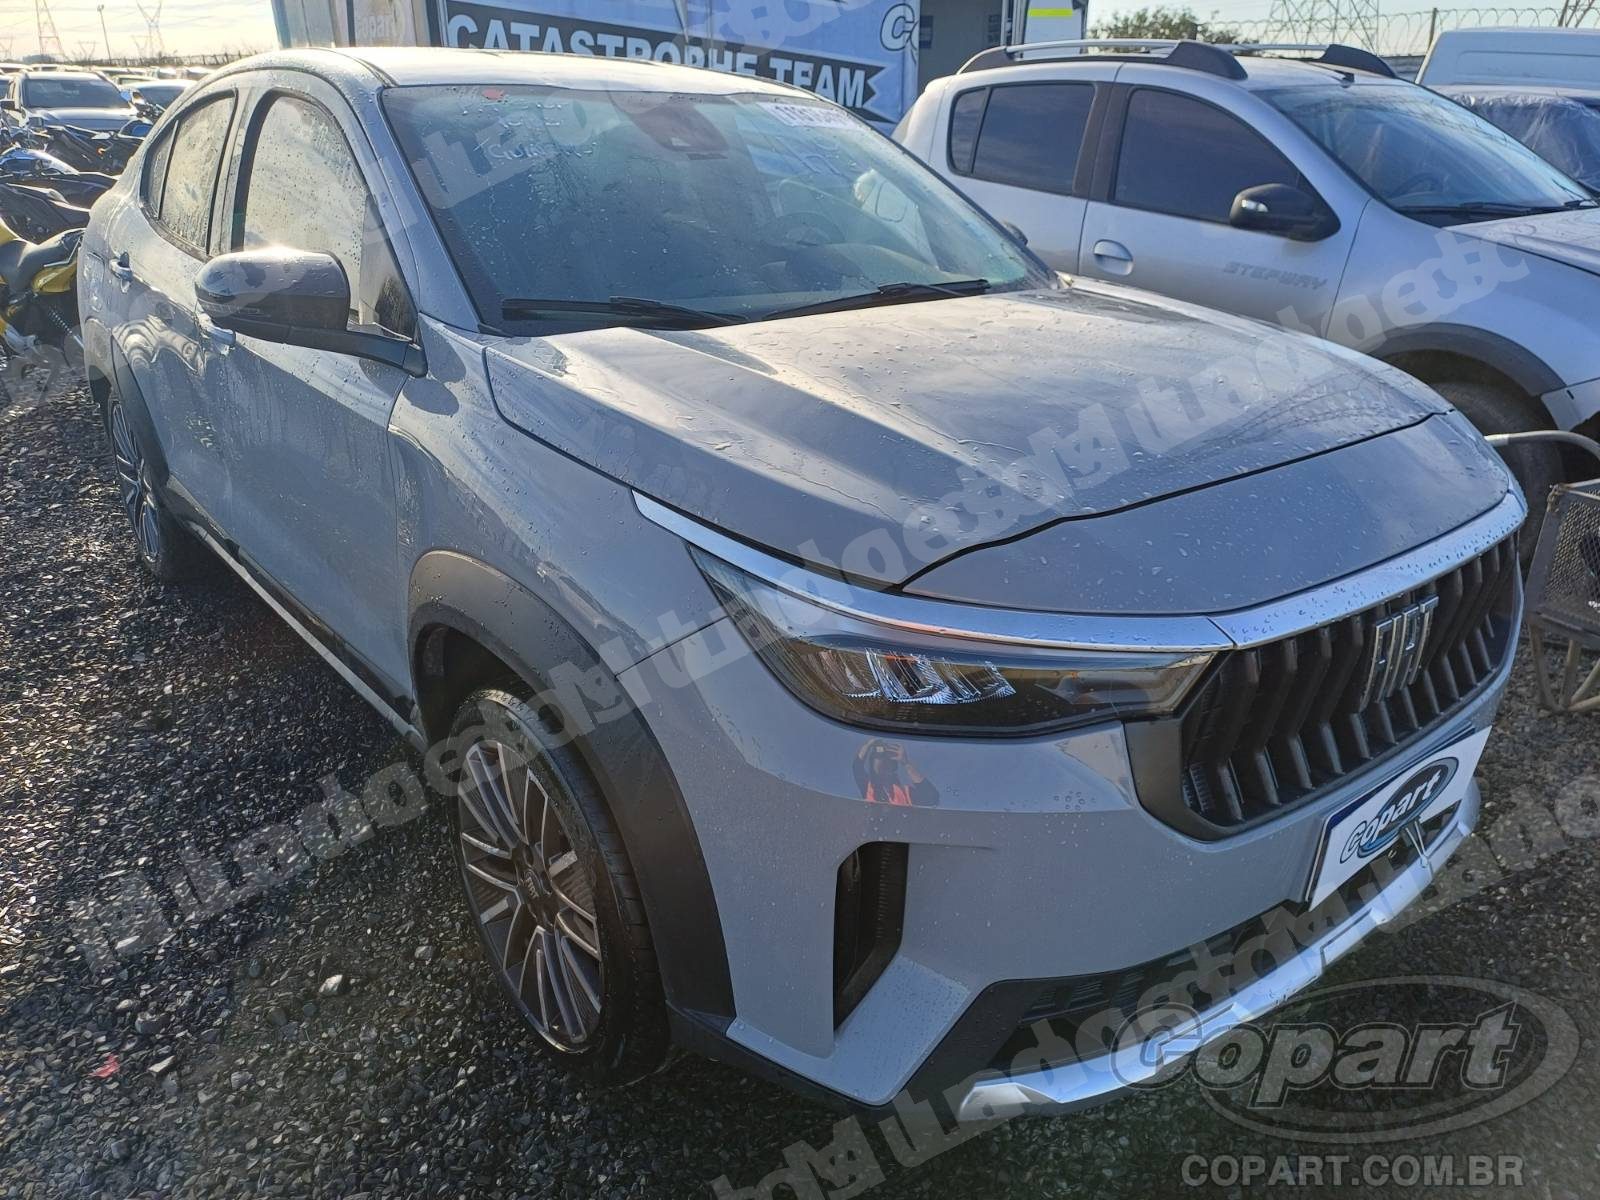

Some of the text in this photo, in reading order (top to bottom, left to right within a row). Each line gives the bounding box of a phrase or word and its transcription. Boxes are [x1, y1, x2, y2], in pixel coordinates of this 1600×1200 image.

[448, 14, 759, 77] CATASTROPHE
[769, 57, 867, 109] TEAM
[1223, 261, 1329, 290] STEPWAY
[1340, 769, 1442, 864] Copart
